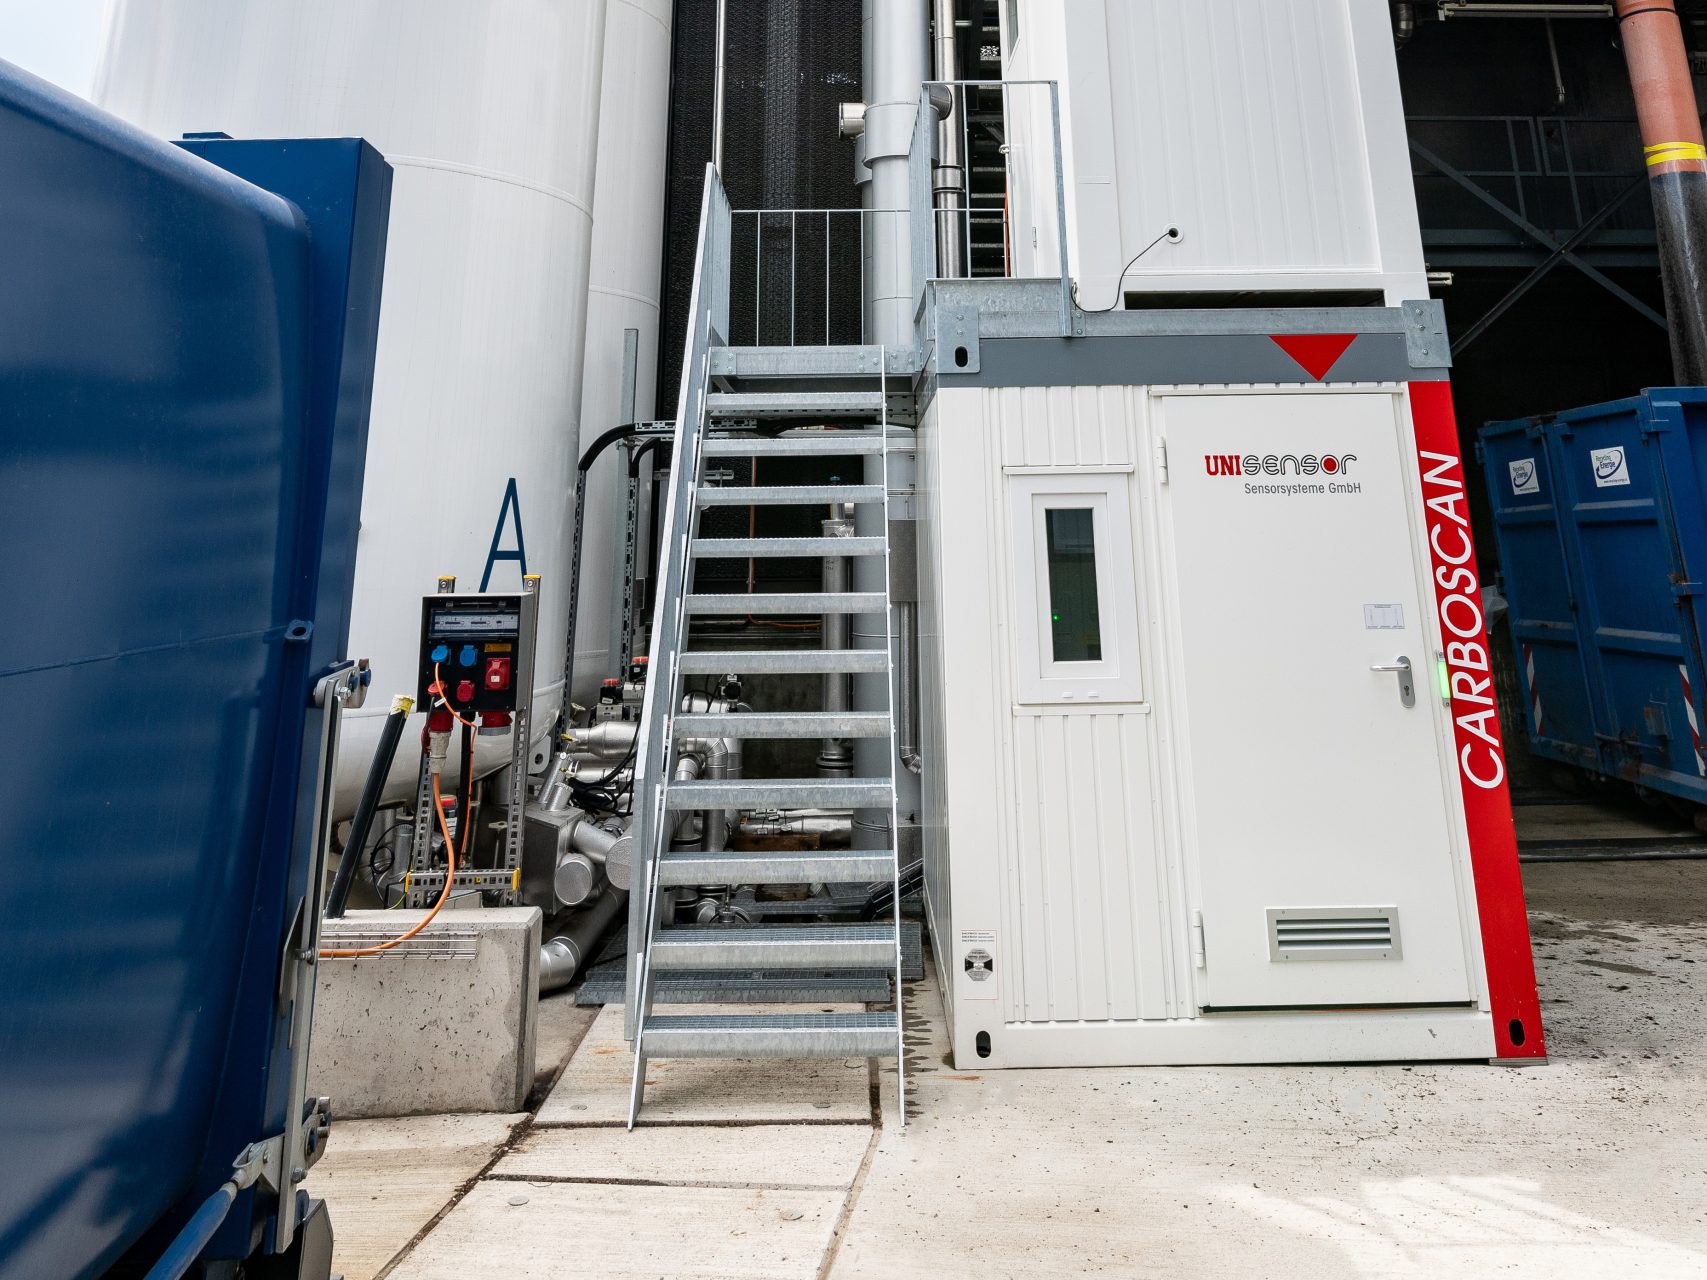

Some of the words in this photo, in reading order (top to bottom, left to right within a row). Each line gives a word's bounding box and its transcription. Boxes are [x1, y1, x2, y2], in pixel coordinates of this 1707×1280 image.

[479, 477, 528, 593] A
[1244, 482, 1325, 496] Sensorsysteme
[1328, 482, 1361, 494] GmbH
[1420, 450, 1504, 789] CARBOSCAN
